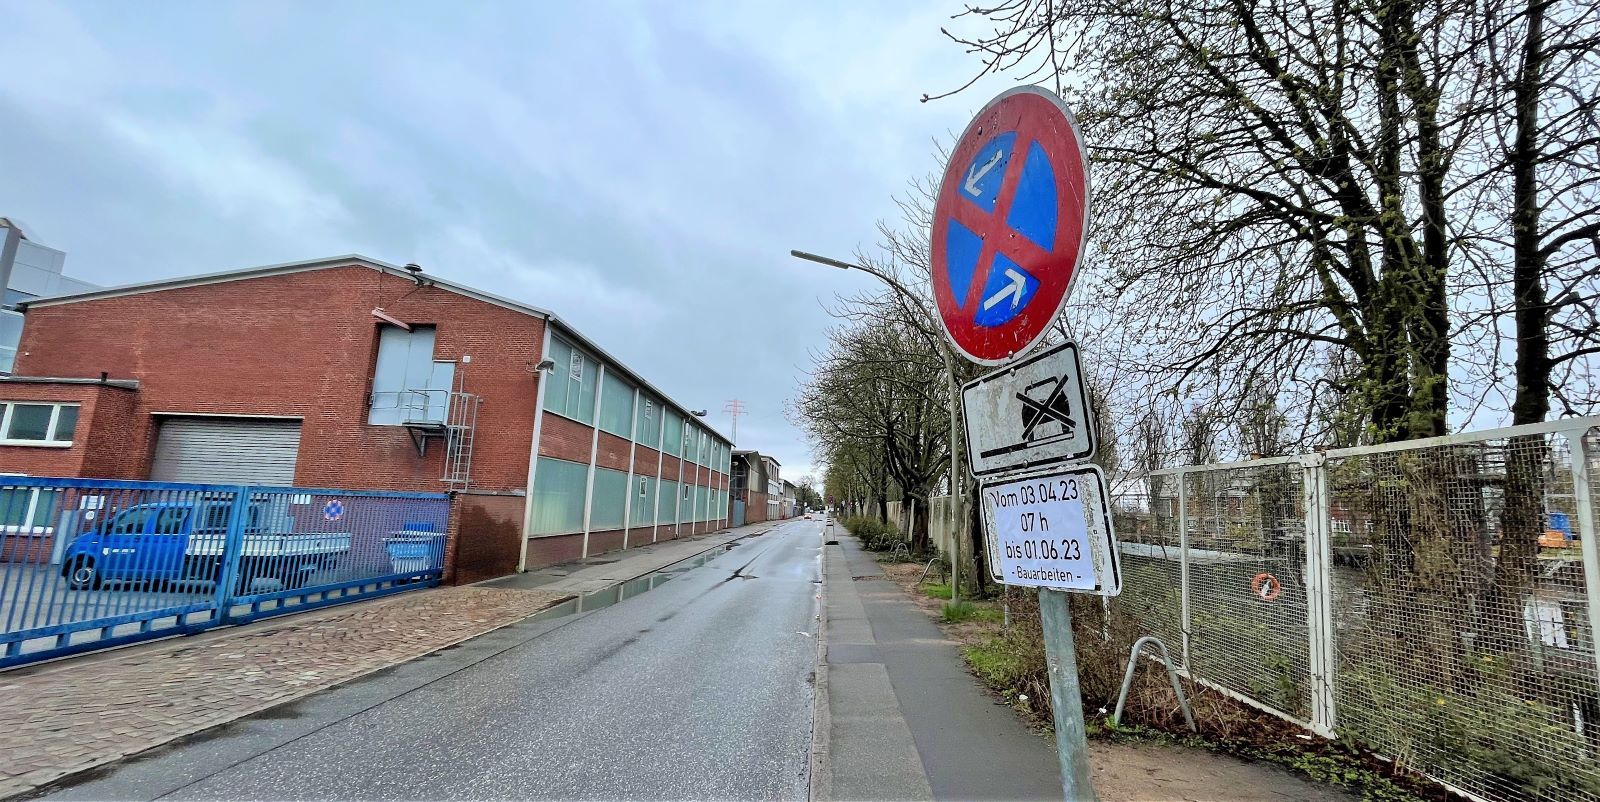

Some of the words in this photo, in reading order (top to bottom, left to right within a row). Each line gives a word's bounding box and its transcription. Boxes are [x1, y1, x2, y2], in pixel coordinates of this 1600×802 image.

[990, 490, 1018, 508] Vom
[1020, 479, 1078, 505] 03.04.23
[1020, 513, 1035, 532] 07
[1039, 512, 1049, 531] h
[1005, 540, 1022, 559] bis
[1024, 539, 1081, 560] 01.06.23
[1017, 566, 1073, 582] Bauarbeiten
